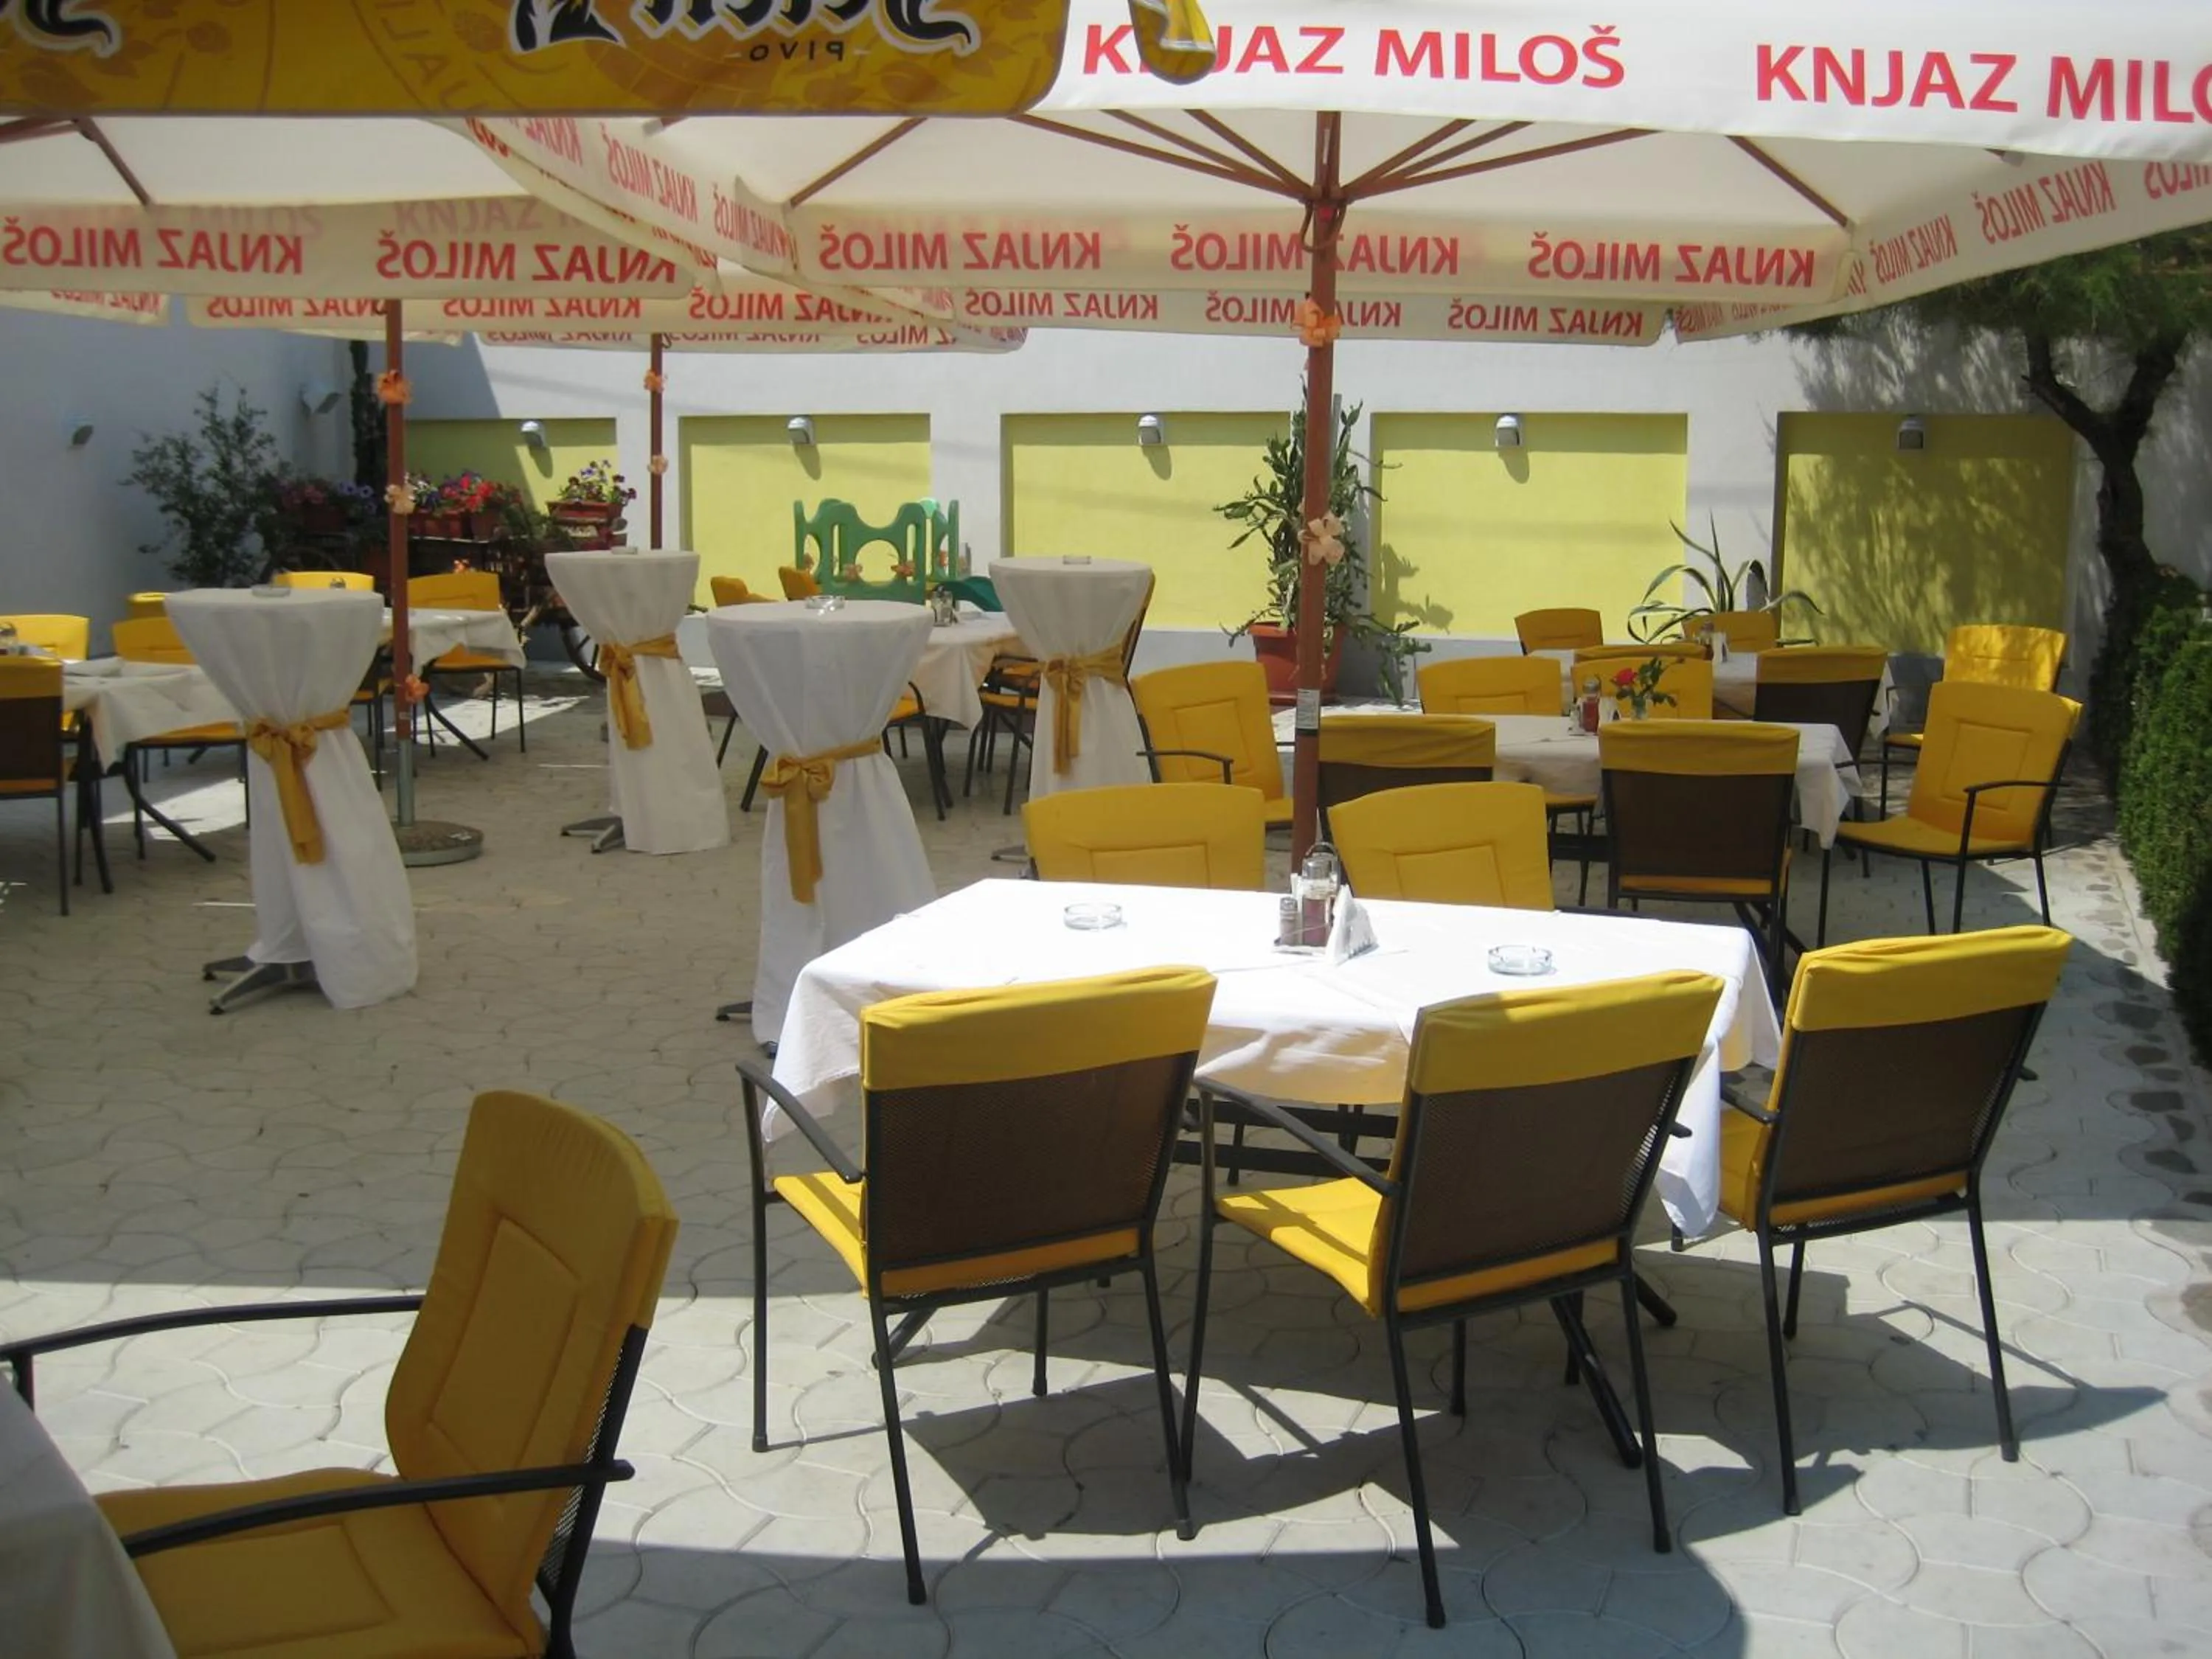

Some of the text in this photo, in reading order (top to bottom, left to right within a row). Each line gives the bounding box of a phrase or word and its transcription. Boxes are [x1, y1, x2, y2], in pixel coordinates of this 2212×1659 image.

[1083, 24, 1624, 88] KJAZ MILOŠ
[1756, 44, 2019, 113] KNJAZ
